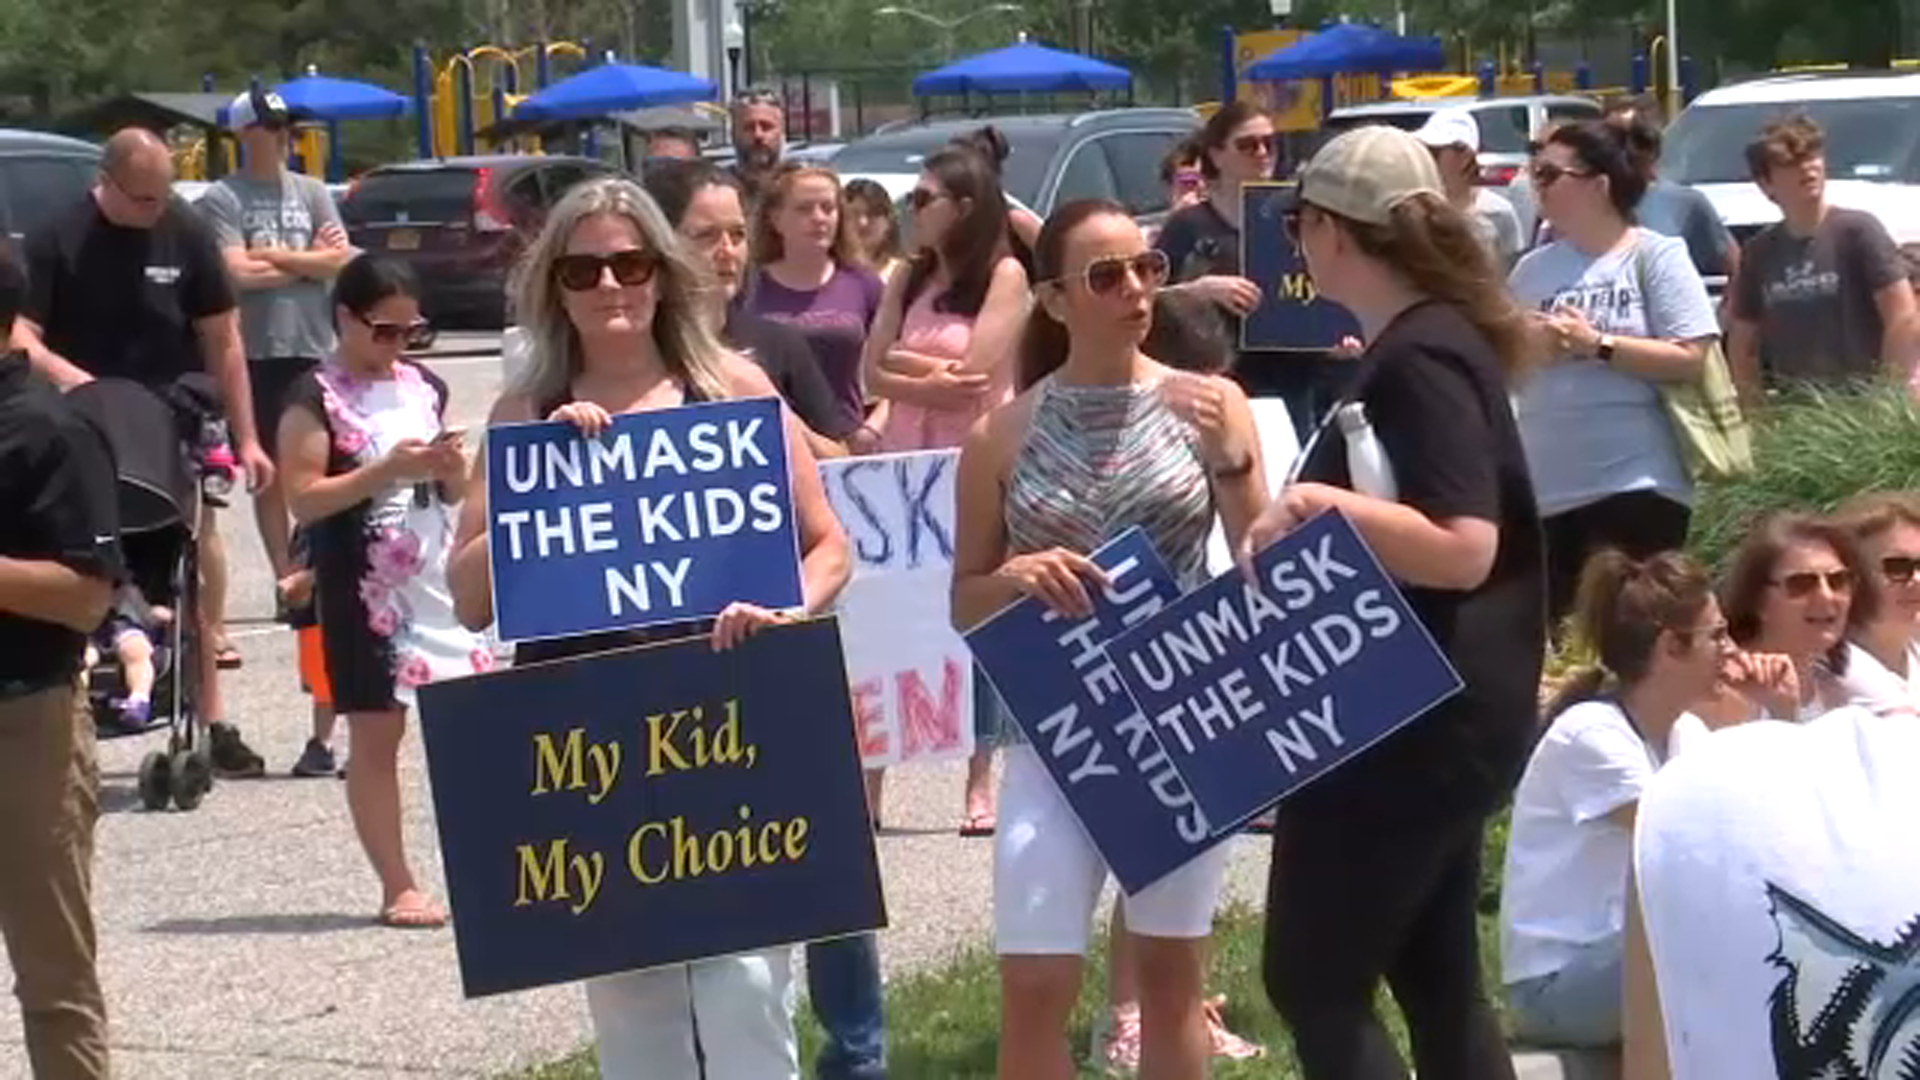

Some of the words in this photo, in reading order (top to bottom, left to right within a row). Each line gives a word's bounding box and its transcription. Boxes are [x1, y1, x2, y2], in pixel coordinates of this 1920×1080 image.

[506, 418, 769, 493] UNMASK
[498, 502, 619, 560] THE
[638, 483, 783, 545] KIDS
[605, 558, 693, 616] NY
[1130, 534, 1358, 691] UNMASK
[1156, 668, 1266, 754] THE
[1260, 589, 1400, 697] KIDS
[530, 727, 621, 804] My
[645, 699, 756, 777] Kid,
[1037, 703, 1119, 784] NY
[1265, 695, 1345, 774] NY
[513, 838, 604, 914] My
[628, 804, 808, 884] Choice
